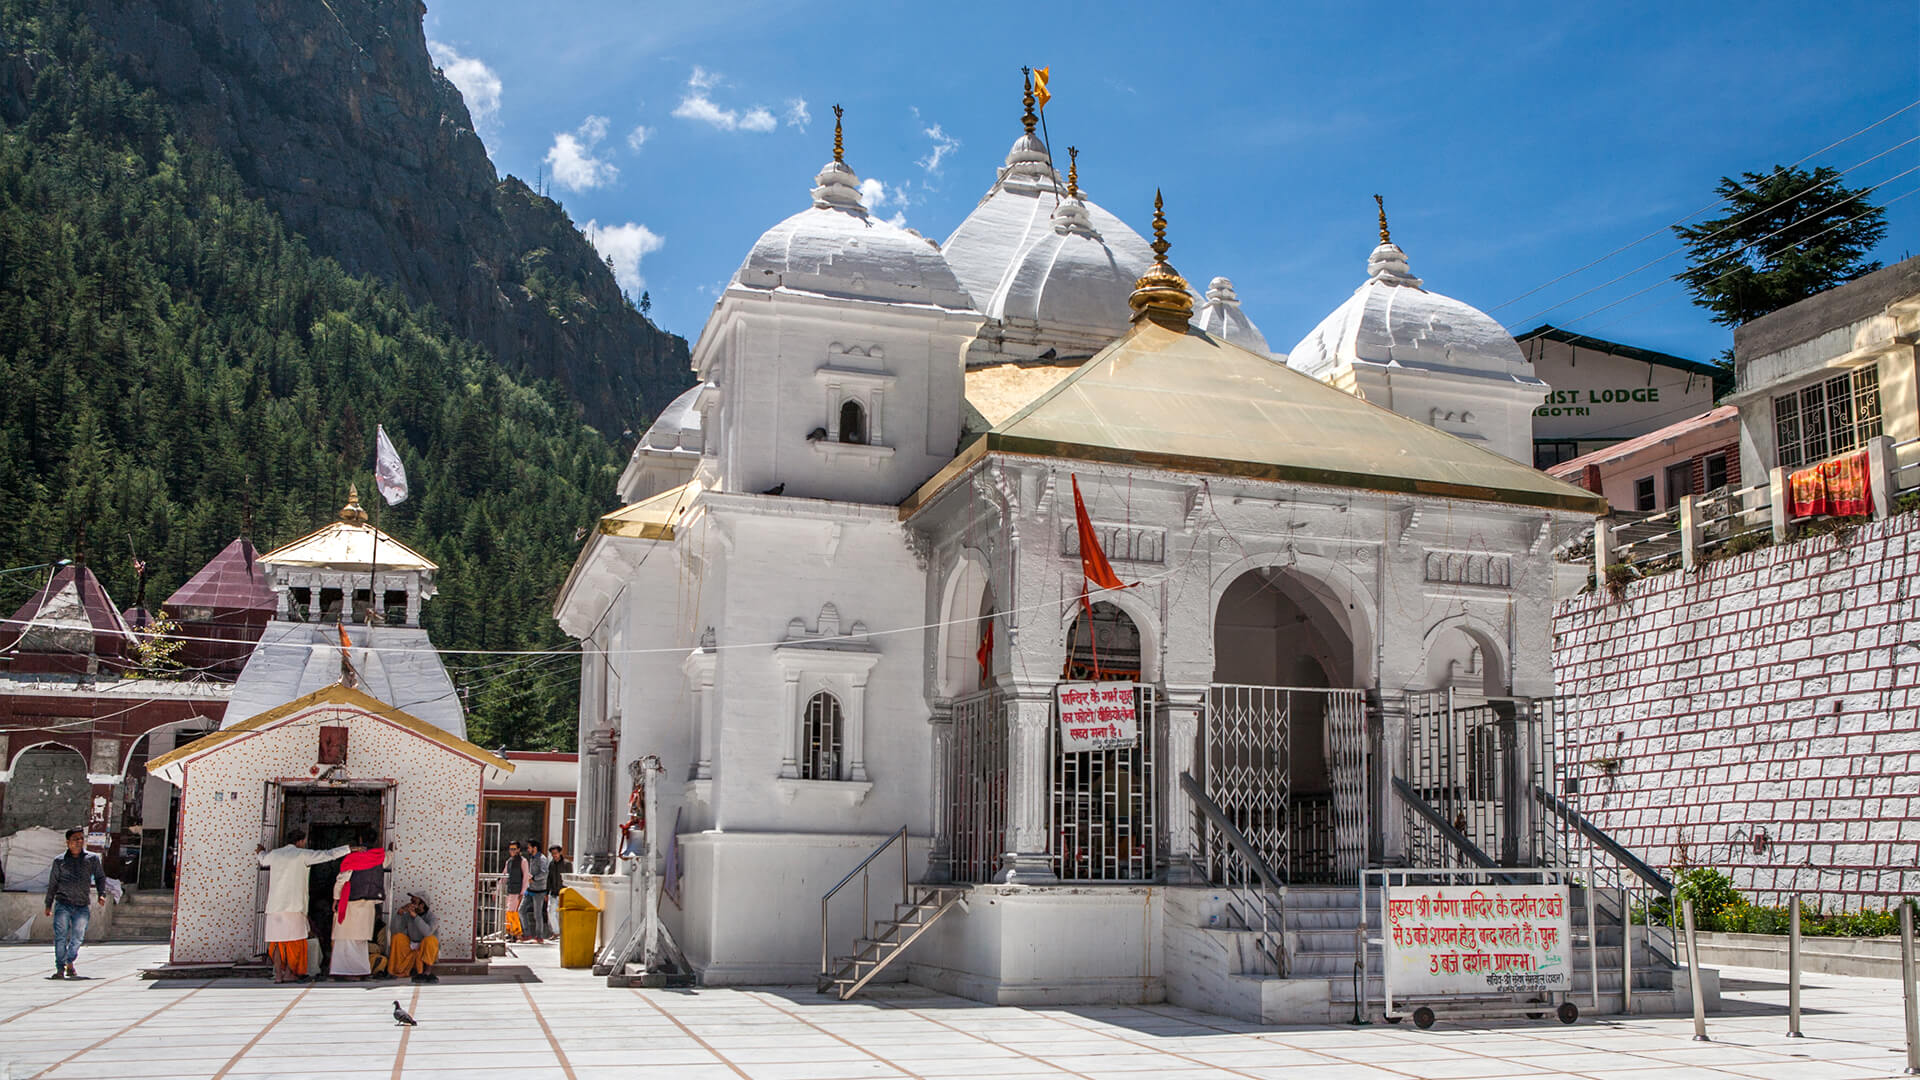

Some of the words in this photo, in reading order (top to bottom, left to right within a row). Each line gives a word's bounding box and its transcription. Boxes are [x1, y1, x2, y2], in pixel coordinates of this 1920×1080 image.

[1590, 388, 1659, 403] LODGE
[1090, 688, 1100, 704] के
[1062, 712, 1073, 723] का
[1090, 727, 1107, 738] मना
[1389, 899, 1414, 924] मुख्य
[1416, 894, 1430, 918] श्री
[1433, 890, 1459, 918] गंगा
[1461, 889, 1495, 918] मन्दिर
[1496, 893, 1509, 918] के
[1510, 893, 1537, 918] दर्शन
[1545, 893, 1563, 918] बजे
[1393, 924, 1403, 946] से
[1412, 923, 1428, 945] बजे
[1430, 927, 1457, 946] शयन
[1459, 923, 1477, 949] हेतु
[1478, 927, 1497, 946] बन्द
[1498, 923, 1520, 946] रहते
[1538, 927, 1558, 950] पुनः
[1440, 949, 1459, 973] बजे
[1461, 949, 1491, 973] दर्शन
